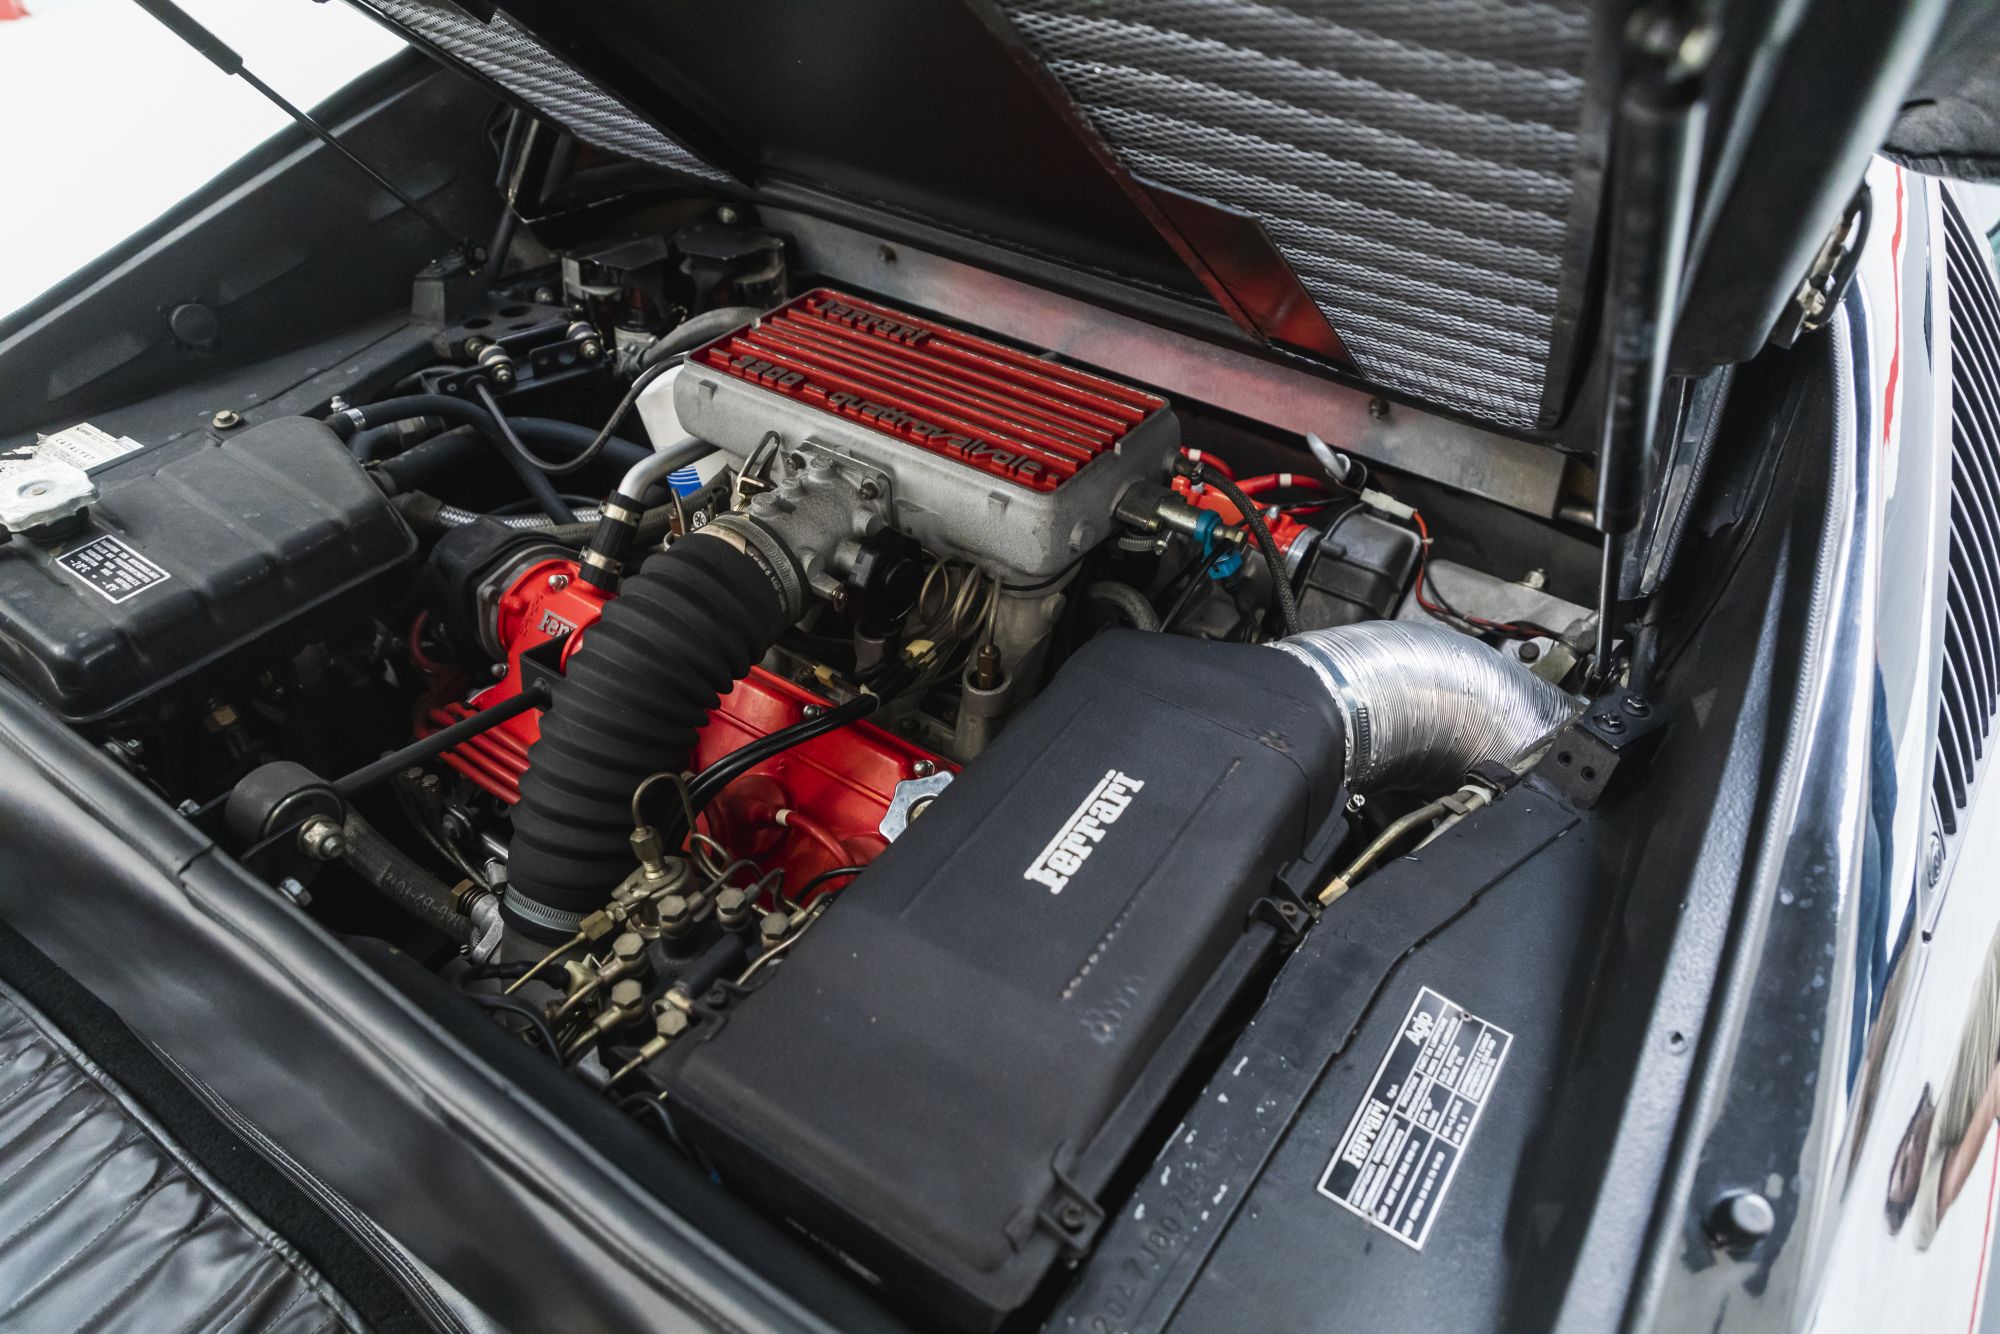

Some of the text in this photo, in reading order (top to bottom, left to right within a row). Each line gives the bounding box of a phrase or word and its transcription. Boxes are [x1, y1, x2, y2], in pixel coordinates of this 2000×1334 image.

[816, 300, 931, 344] Ferrari
[731, 355, 1042, 477] 3200 quattrovalvole
[536, 608, 578, 637] Fer
[1024, 769, 1145, 895] Ferrari
[1405, 1011, 1434, 1046] Agip
[1341, 1098, 1390, 1169] Ferrari
